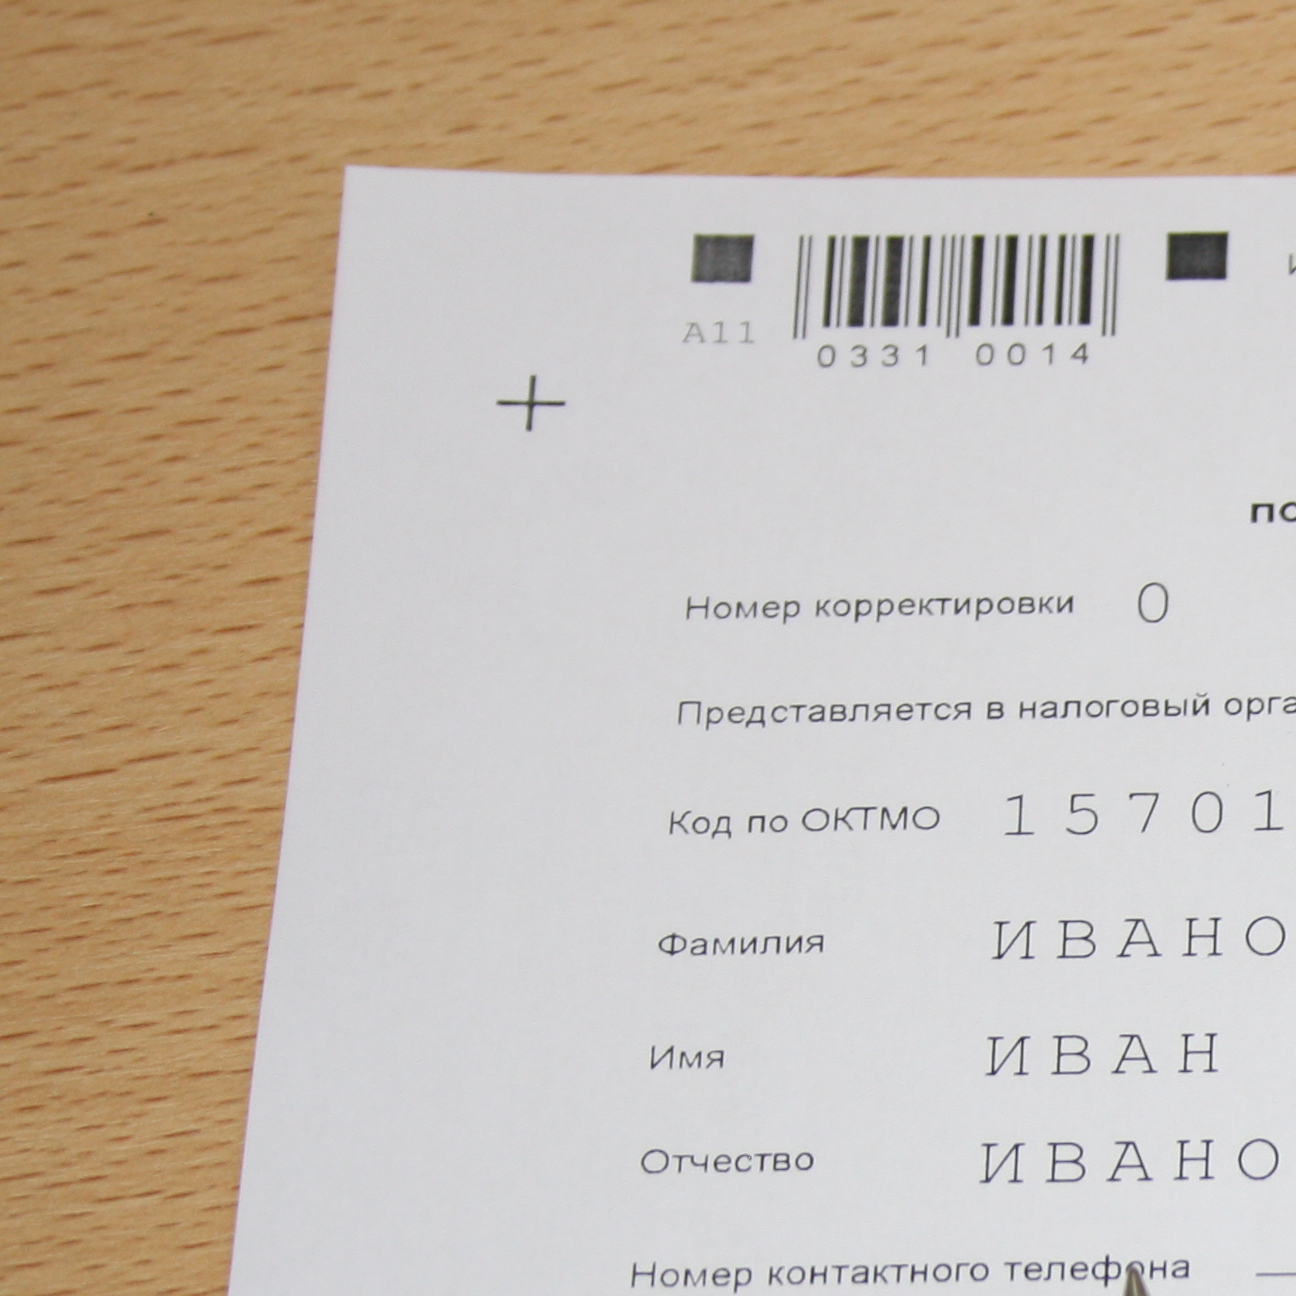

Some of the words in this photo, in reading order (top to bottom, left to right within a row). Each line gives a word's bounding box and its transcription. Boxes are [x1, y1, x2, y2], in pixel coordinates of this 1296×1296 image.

[816, 343, 928, 369] 0331
[975, 341, 1089, 367] 0014
[685, 595, 801, 626] Номер
[815, 595, 1074, 624] корректировки
[1137, 581, 1169, 624] 0
[677, 700, 972, 732] Представляется
[986, 701, 1005, 720] в
[1018, 692, 1210, 720] налоговый
[669, 810, 732, 840] Код
[747, 814, 789, 834] по
[801, 805, 941, 832] ОКТМО
[657, 932, 825, 957] Фамилия
[650, 1044, 725, 1071] Имя
[985, 1032, 1218, 1077] ИВАН
[640, 1148, 815, 1175] Отчество
[630, 1261, 753, 1294] Номер
[768, 1262, 990, 1286] контактного
